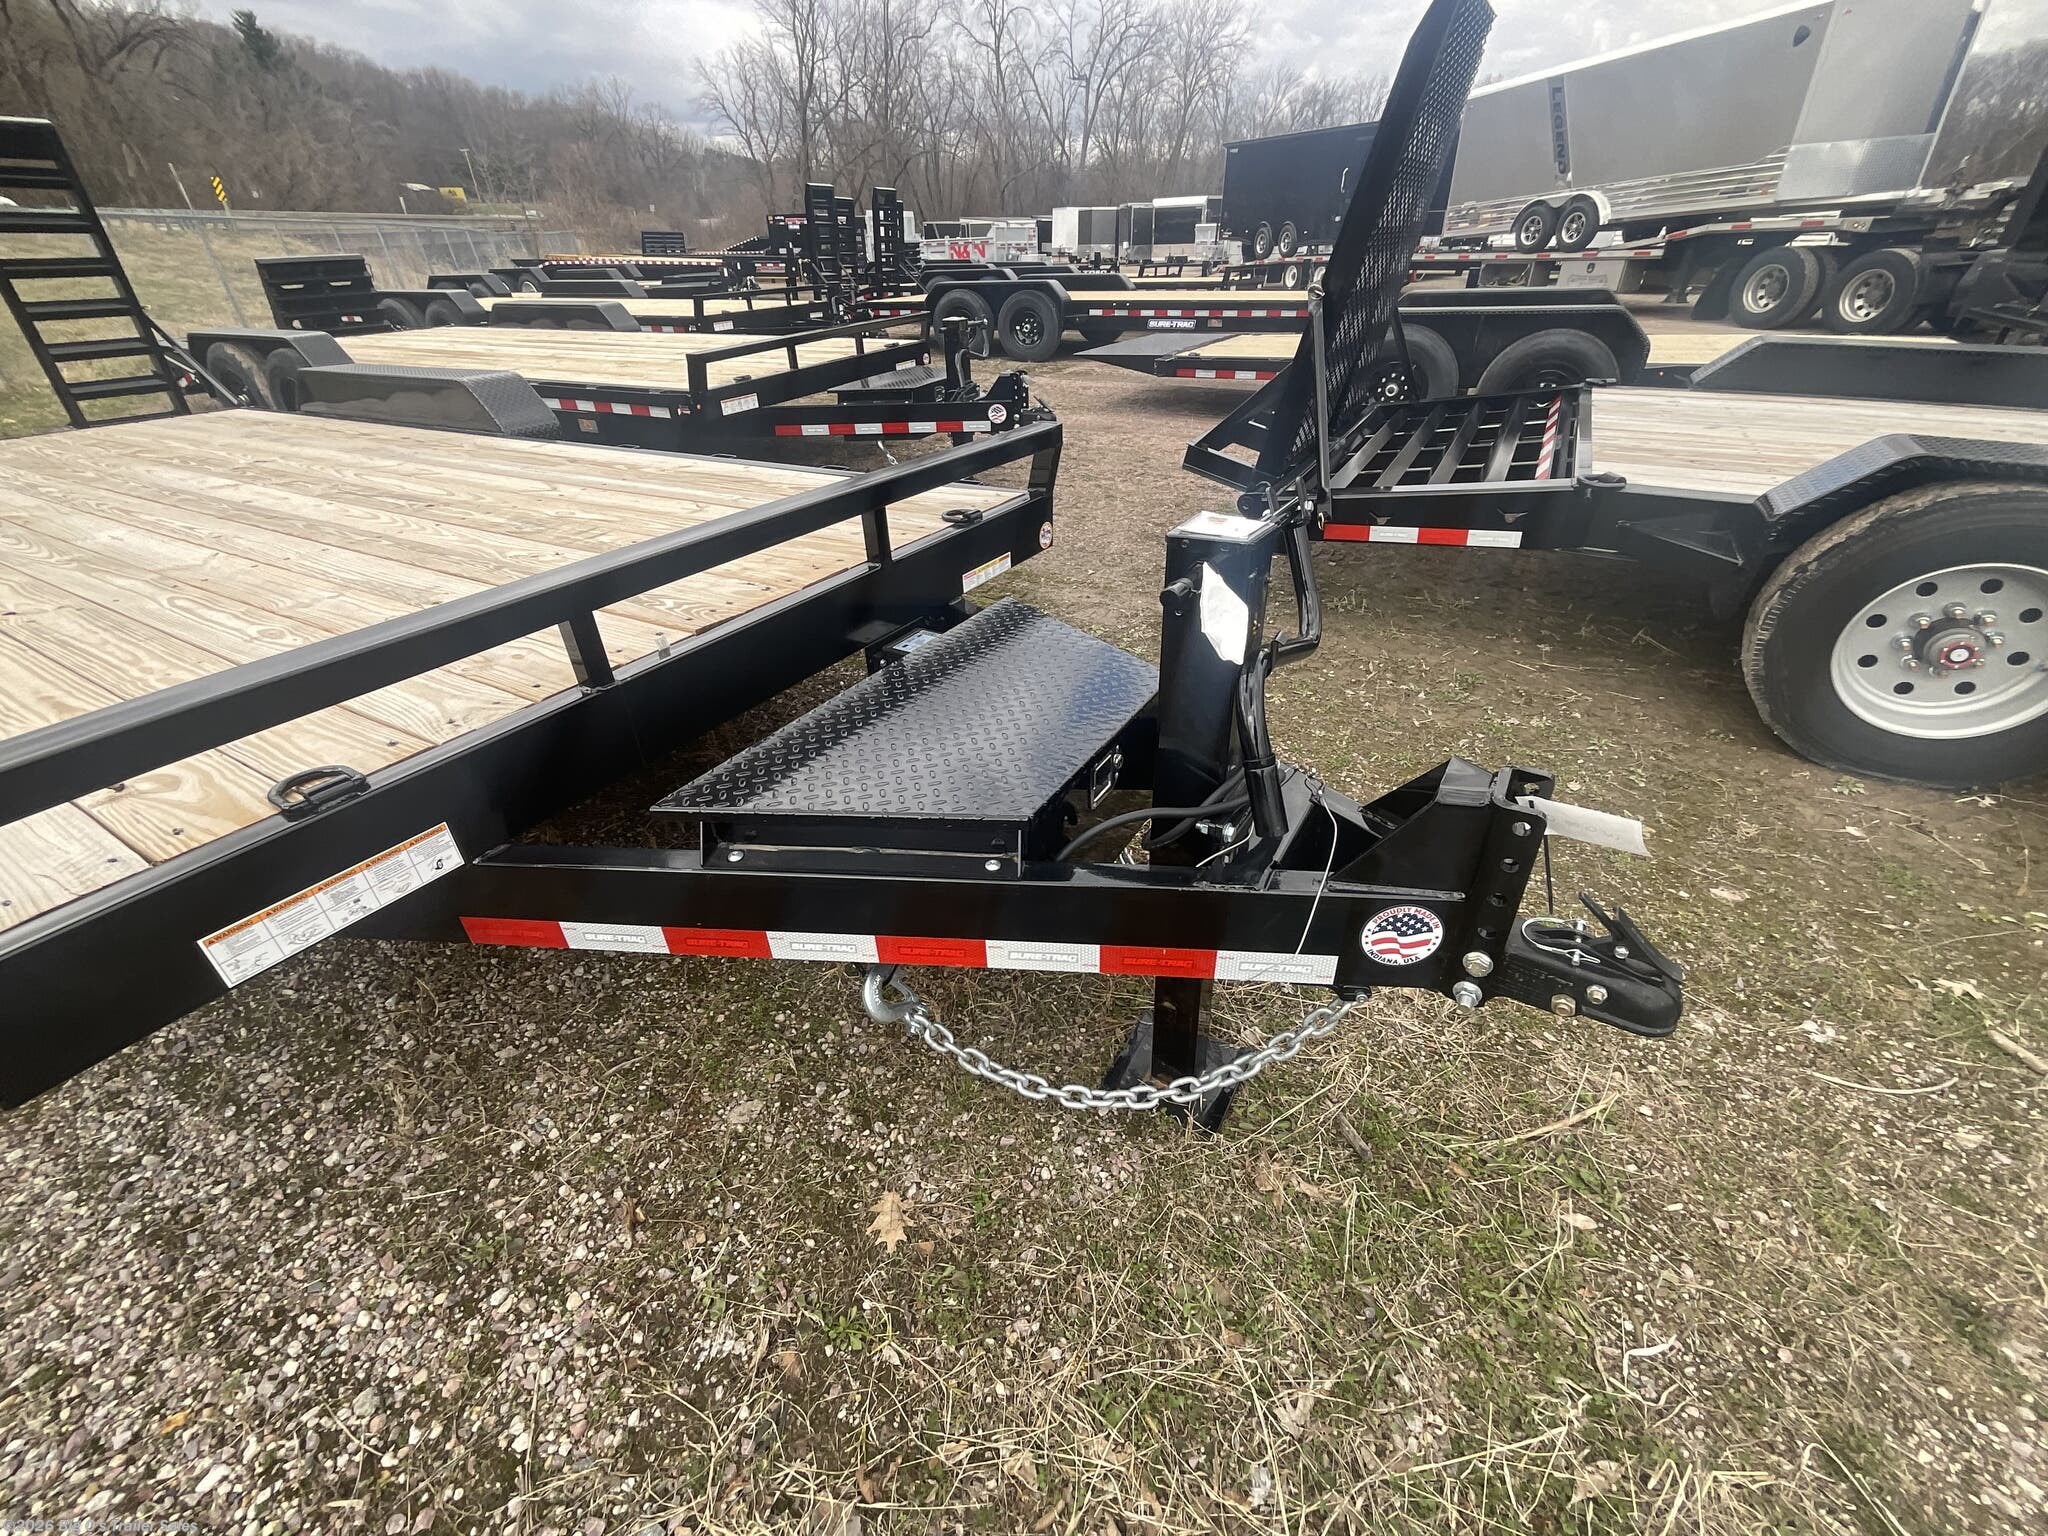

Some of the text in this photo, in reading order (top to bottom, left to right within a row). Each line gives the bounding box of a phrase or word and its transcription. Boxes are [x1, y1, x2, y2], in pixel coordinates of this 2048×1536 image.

[1148, 319, 1196, 329] SURE-TRAC
[323, 869, 357, 888] WARNING
[272, 894, 308, 913] WARNING
[1372, 907, 1411, 924] PROUDLY
[1414, 908, 1436, 923] MADE
[213, 921, 253, 941] WARNING
[584, 932, 647, 944] SURE-TRAC
[791, 942, 857, 953] SURE-TRAC
[1008, 951, 1079, 963] SURE-TRAC
[1367, 949, 1421, 965] INDIANA, USA
[1239, 961, 1313, 975] SURE-TRAC
